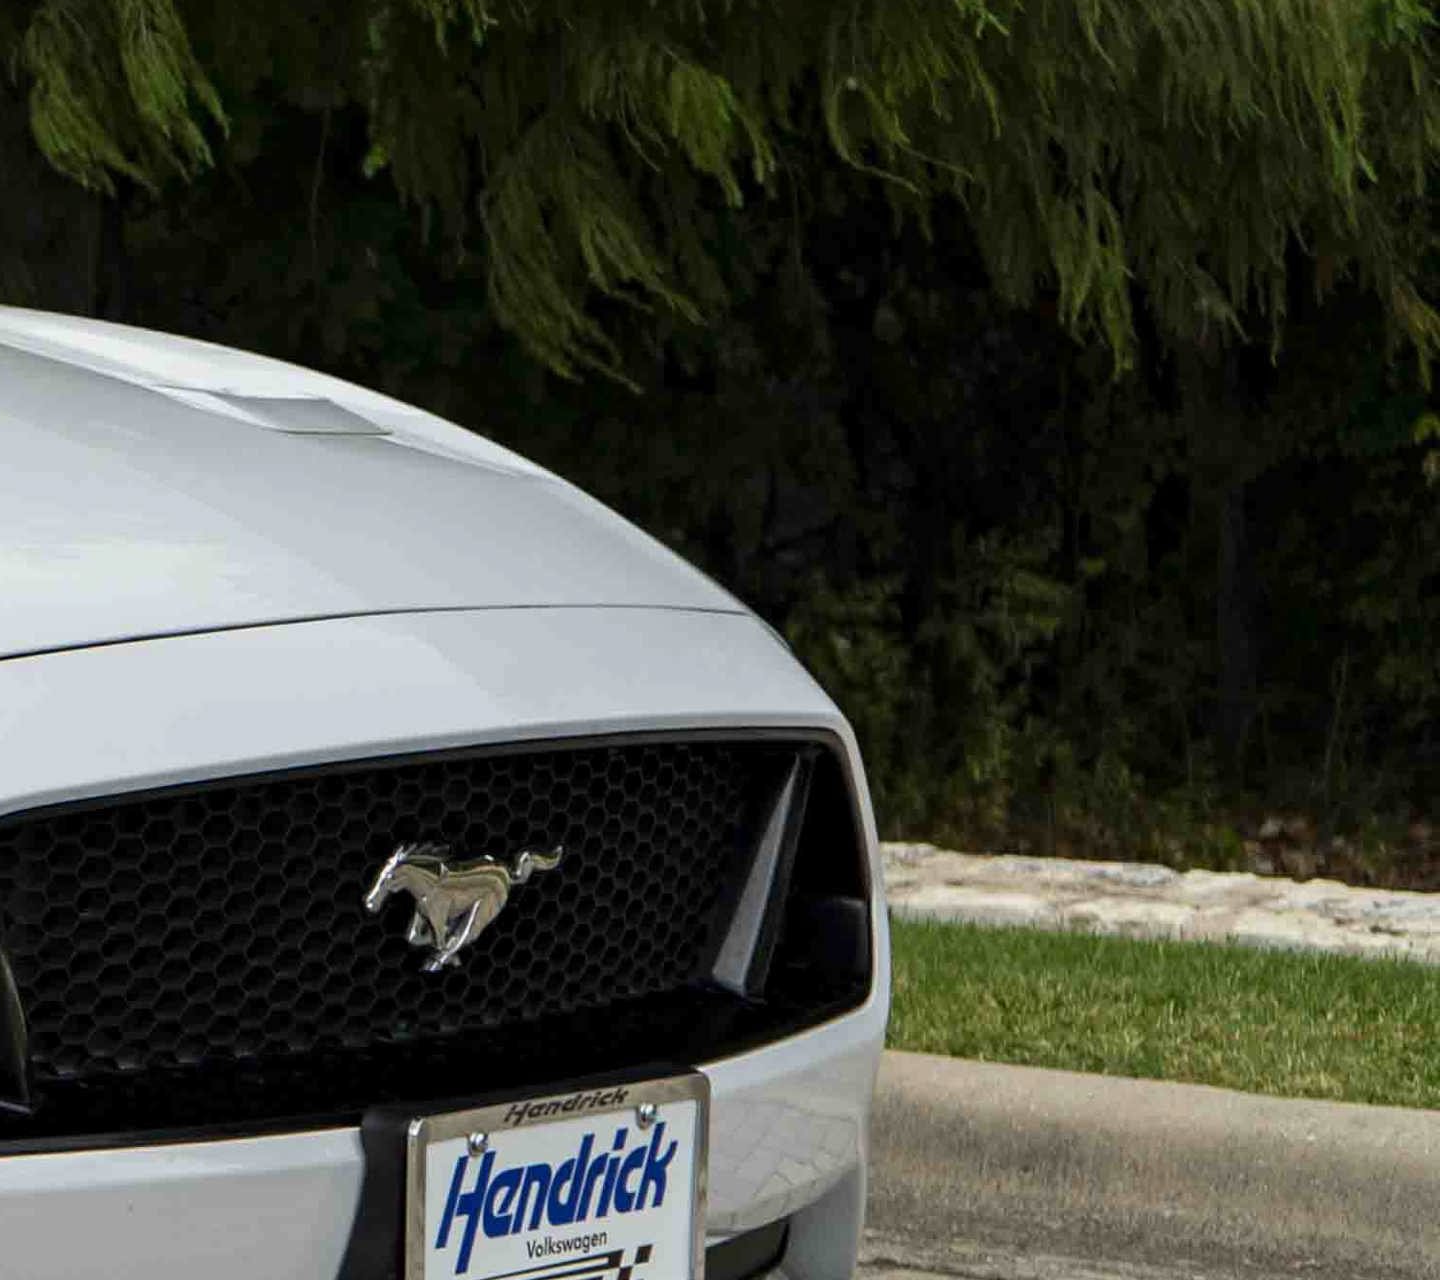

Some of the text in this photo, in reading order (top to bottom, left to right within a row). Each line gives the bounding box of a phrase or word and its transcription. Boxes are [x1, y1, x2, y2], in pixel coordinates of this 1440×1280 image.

[503, 1087, 629, 1126] Hendrick
[435, 1121, 679, 1275] Hendrick
[526, 1231, 608, 1260] Volkswagen
